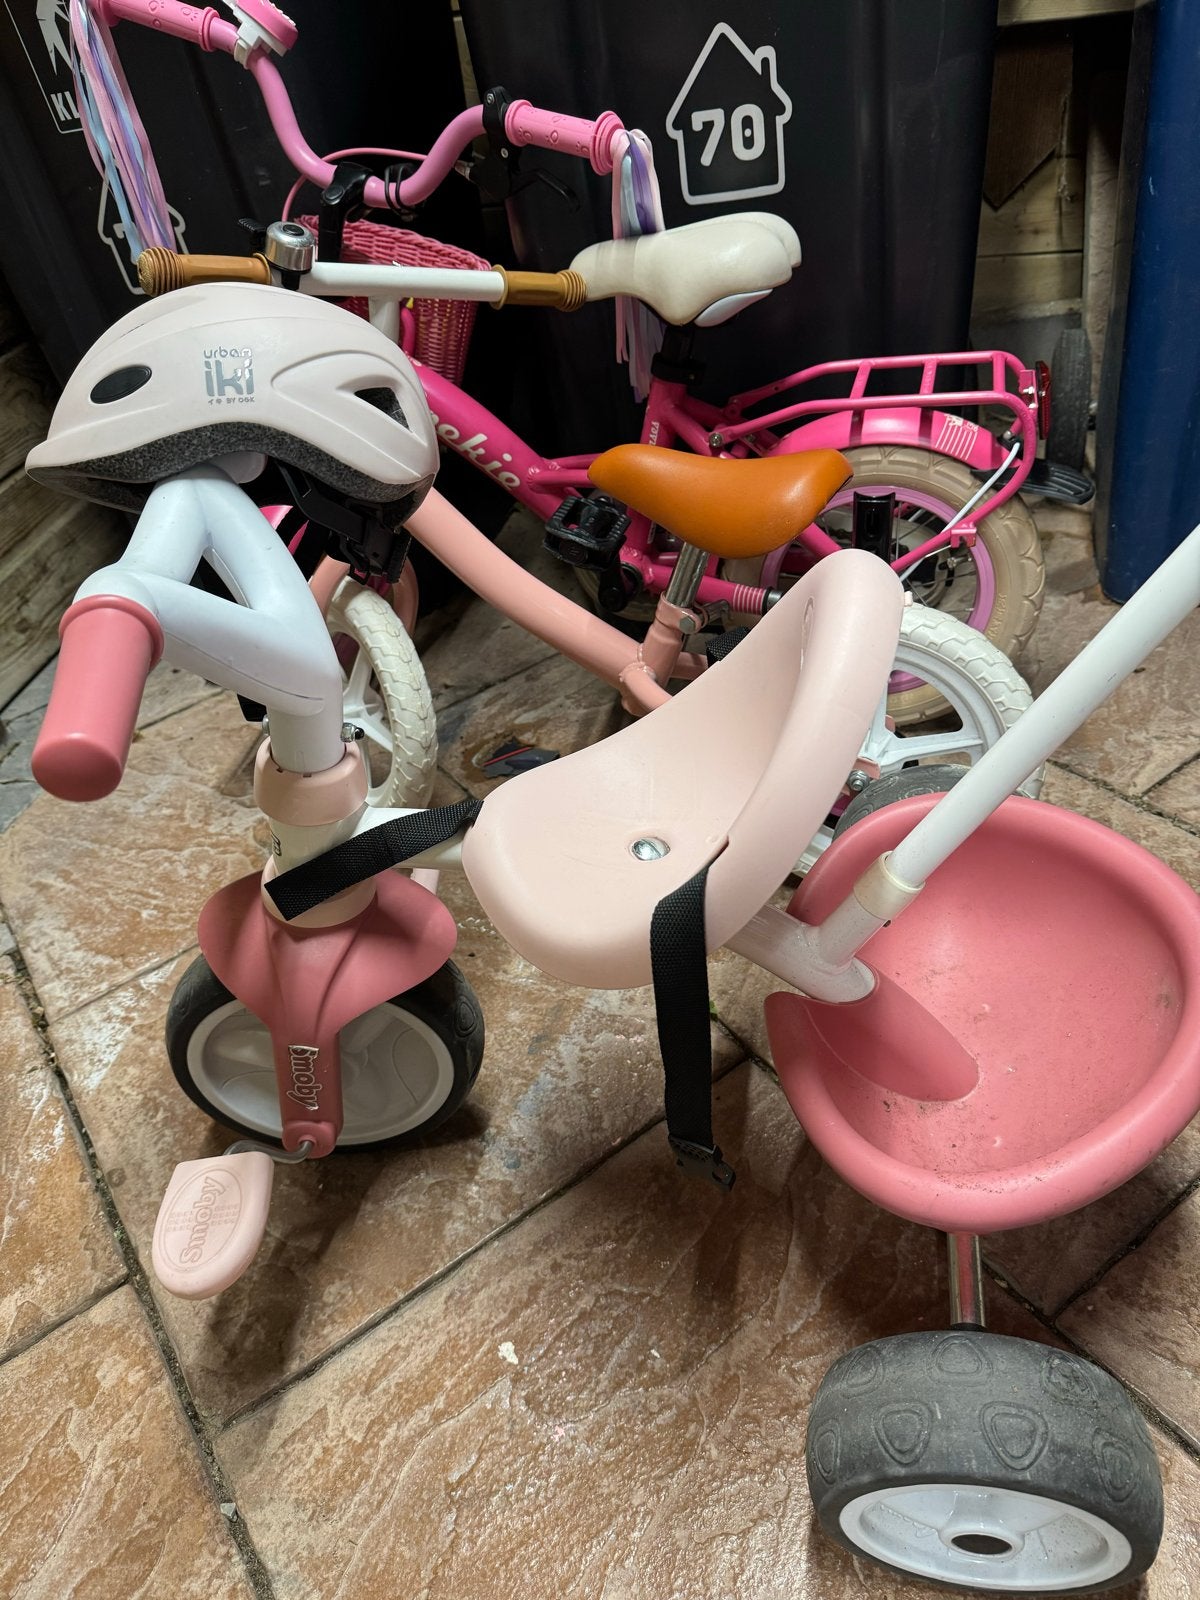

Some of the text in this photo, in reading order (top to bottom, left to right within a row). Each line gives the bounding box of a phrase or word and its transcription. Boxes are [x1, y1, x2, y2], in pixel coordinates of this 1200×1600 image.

[691, 103, 766, 167] 70
[203, 346, 252, 359] urban
[204, 358, 255, 397] iki
[180, 1175, 226, 1264] Smoby
